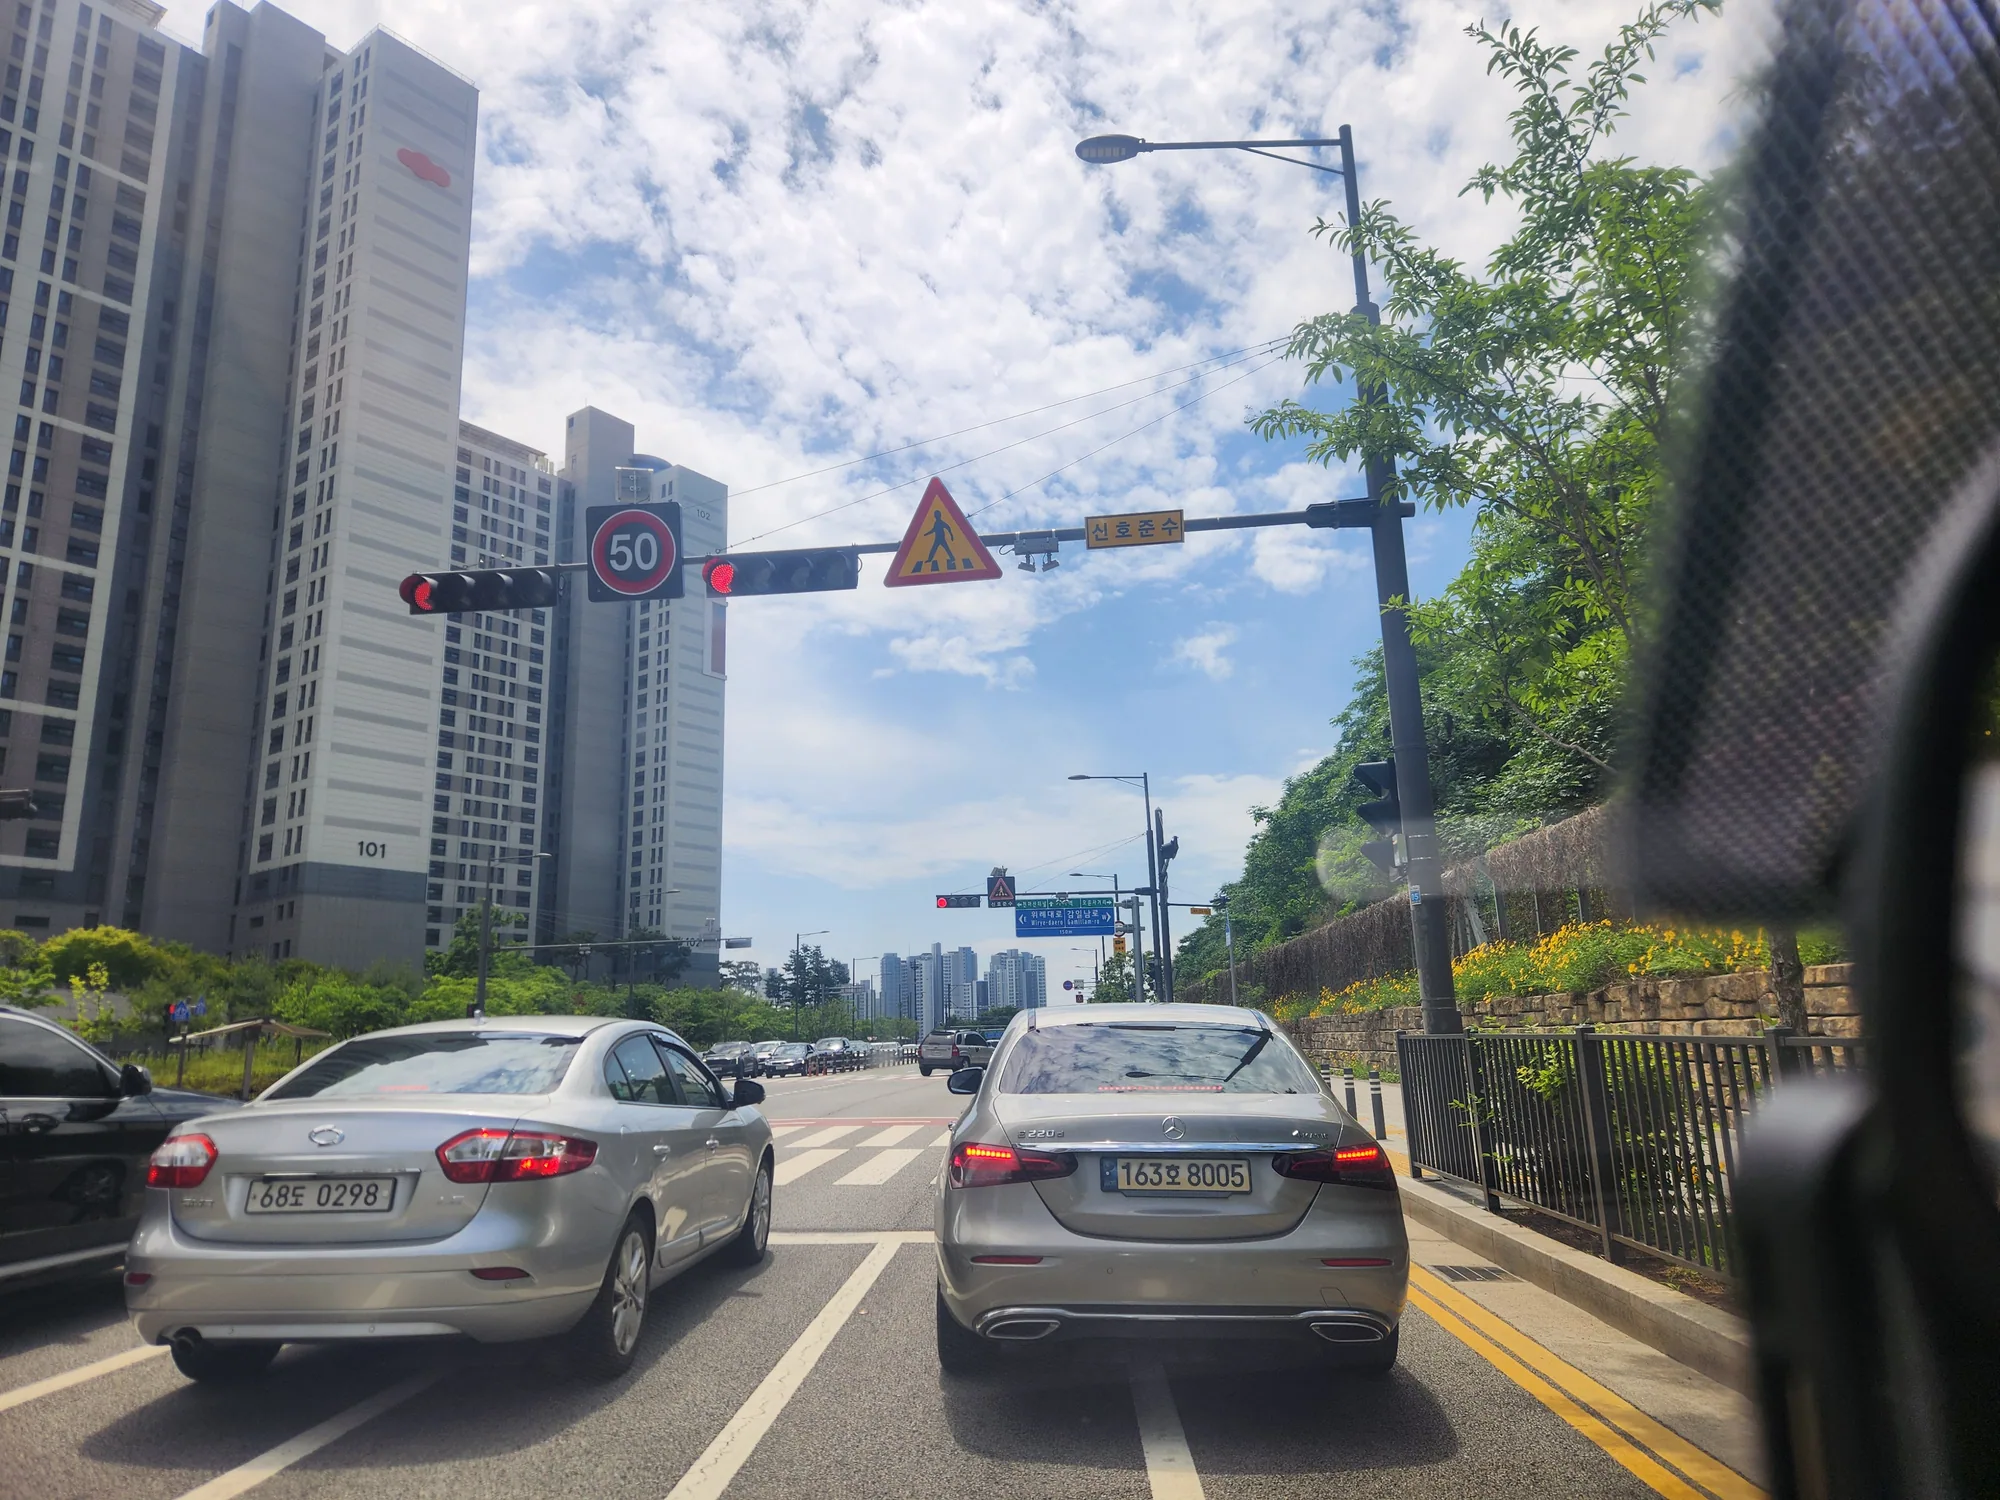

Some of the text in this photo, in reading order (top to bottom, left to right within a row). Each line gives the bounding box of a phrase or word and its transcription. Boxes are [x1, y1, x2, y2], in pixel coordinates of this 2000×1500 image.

[696, 508, 711, 521] 102
[1092, 517, 1179, 542] 신호준수
[609, 532, 658, 572] 50
[357, 840, 386, 859] 101
[1030, 910, 1063, 919] 위례대로
[1067, 909, 1099, 919] 감일남로
[1121, 1162, 1245, 1188] 163호 8005
[260, 1183, 379, 1208] 68도 0298
